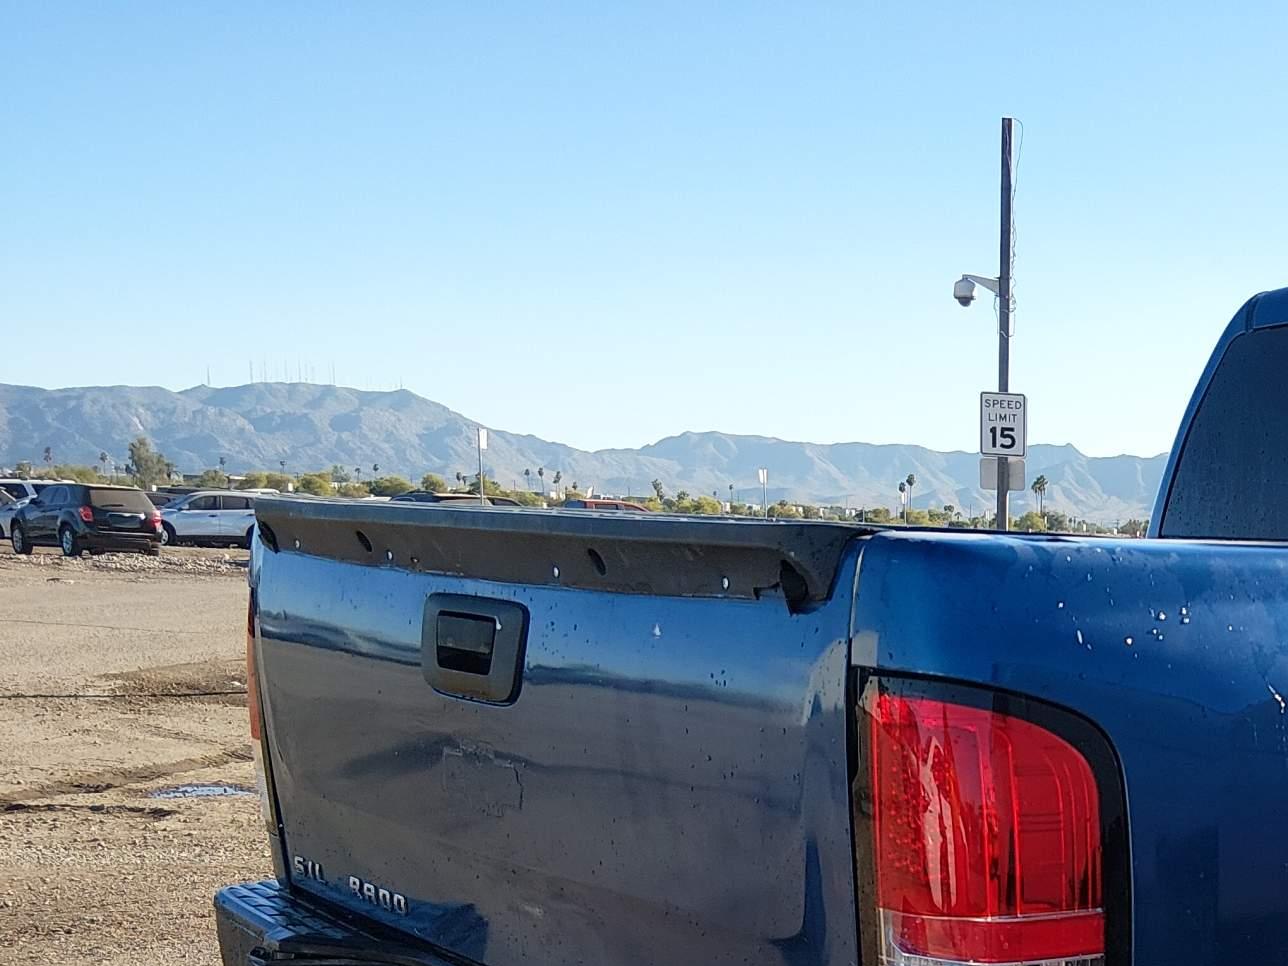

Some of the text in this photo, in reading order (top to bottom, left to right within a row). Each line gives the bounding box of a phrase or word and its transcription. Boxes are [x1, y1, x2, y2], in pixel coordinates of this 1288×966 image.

[984, 398, 1022, 410] SPEED
[988, 412, 1018, 423] LIMIT
[989, 426, 1016, 449] 15
